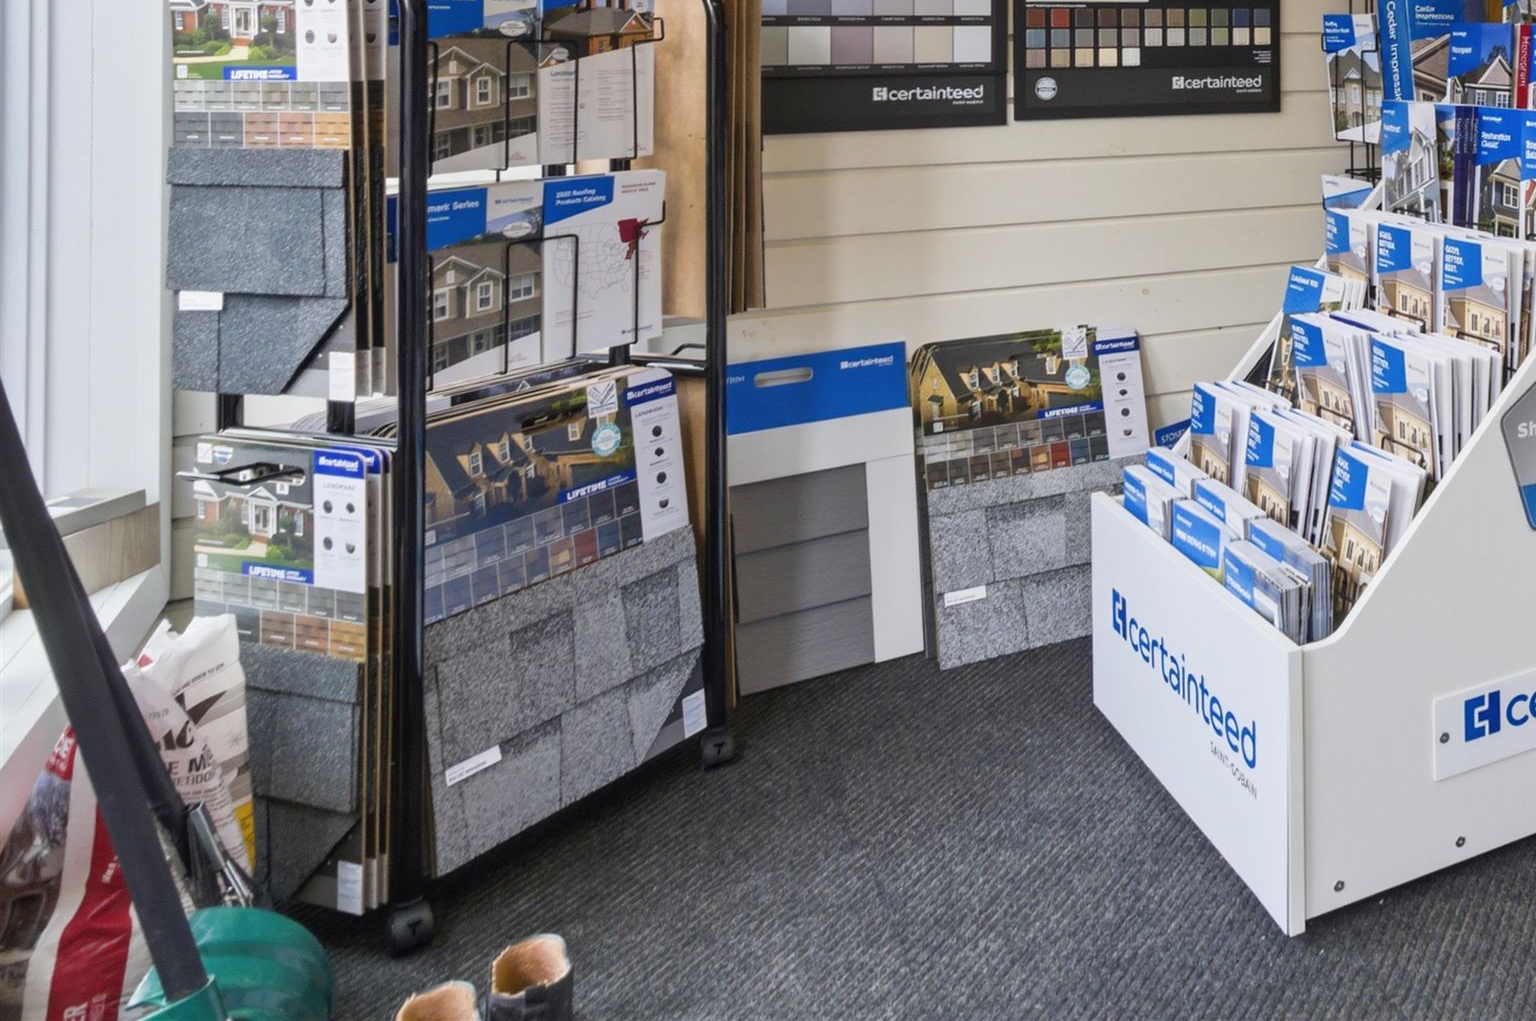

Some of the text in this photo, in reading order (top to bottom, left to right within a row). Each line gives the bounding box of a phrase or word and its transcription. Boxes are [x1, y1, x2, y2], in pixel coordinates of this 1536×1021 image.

[1185, 75, 1262, 90] certainteed
[889, 85, 984, 101] certainteed
[1129, 617, 1256, 769] certainteed
